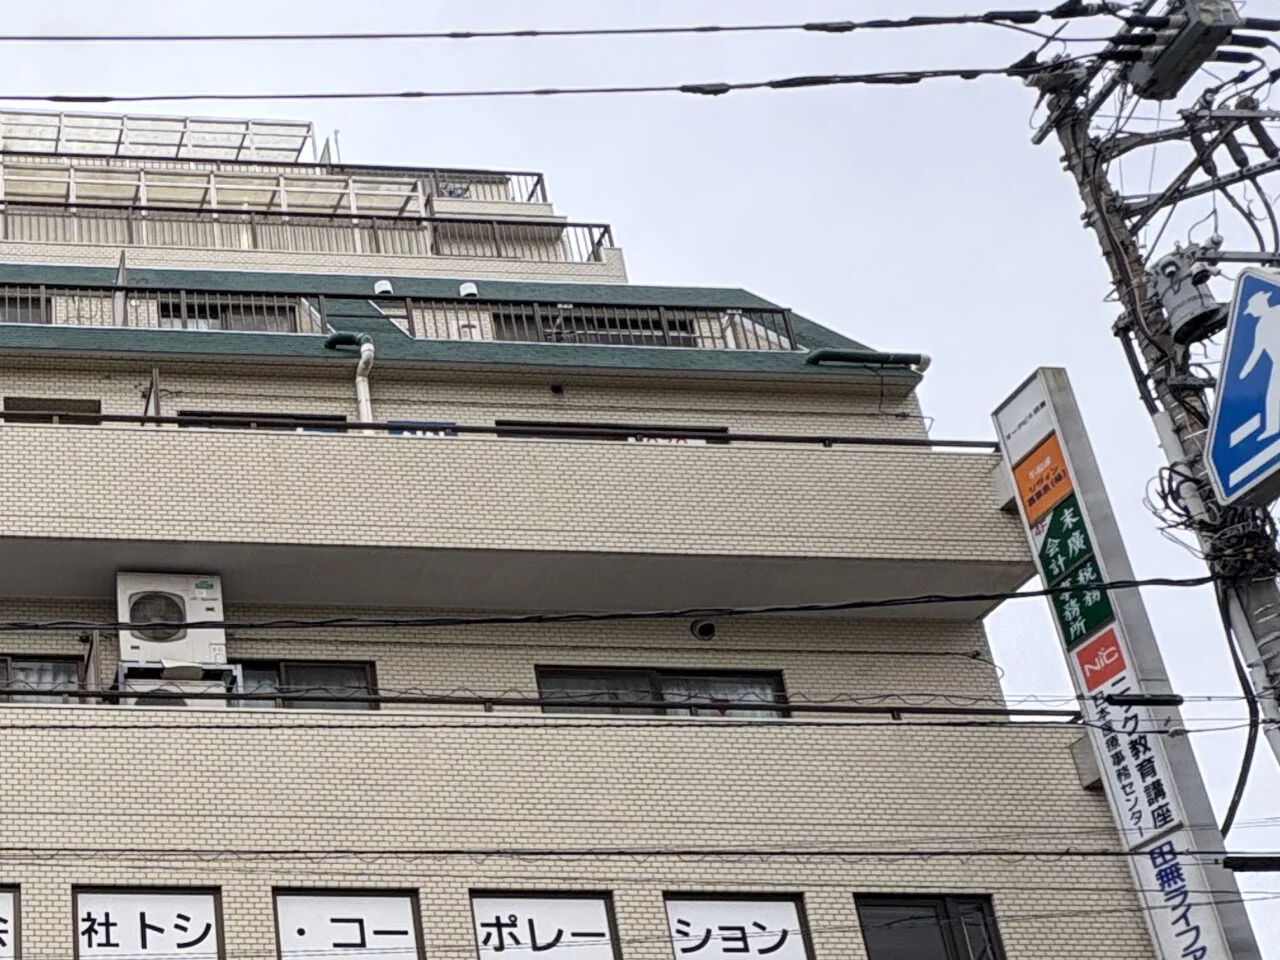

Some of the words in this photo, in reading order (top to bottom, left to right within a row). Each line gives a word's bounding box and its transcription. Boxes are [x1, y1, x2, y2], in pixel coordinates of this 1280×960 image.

[1111, 675, 1174, 830] ニク教育講座
